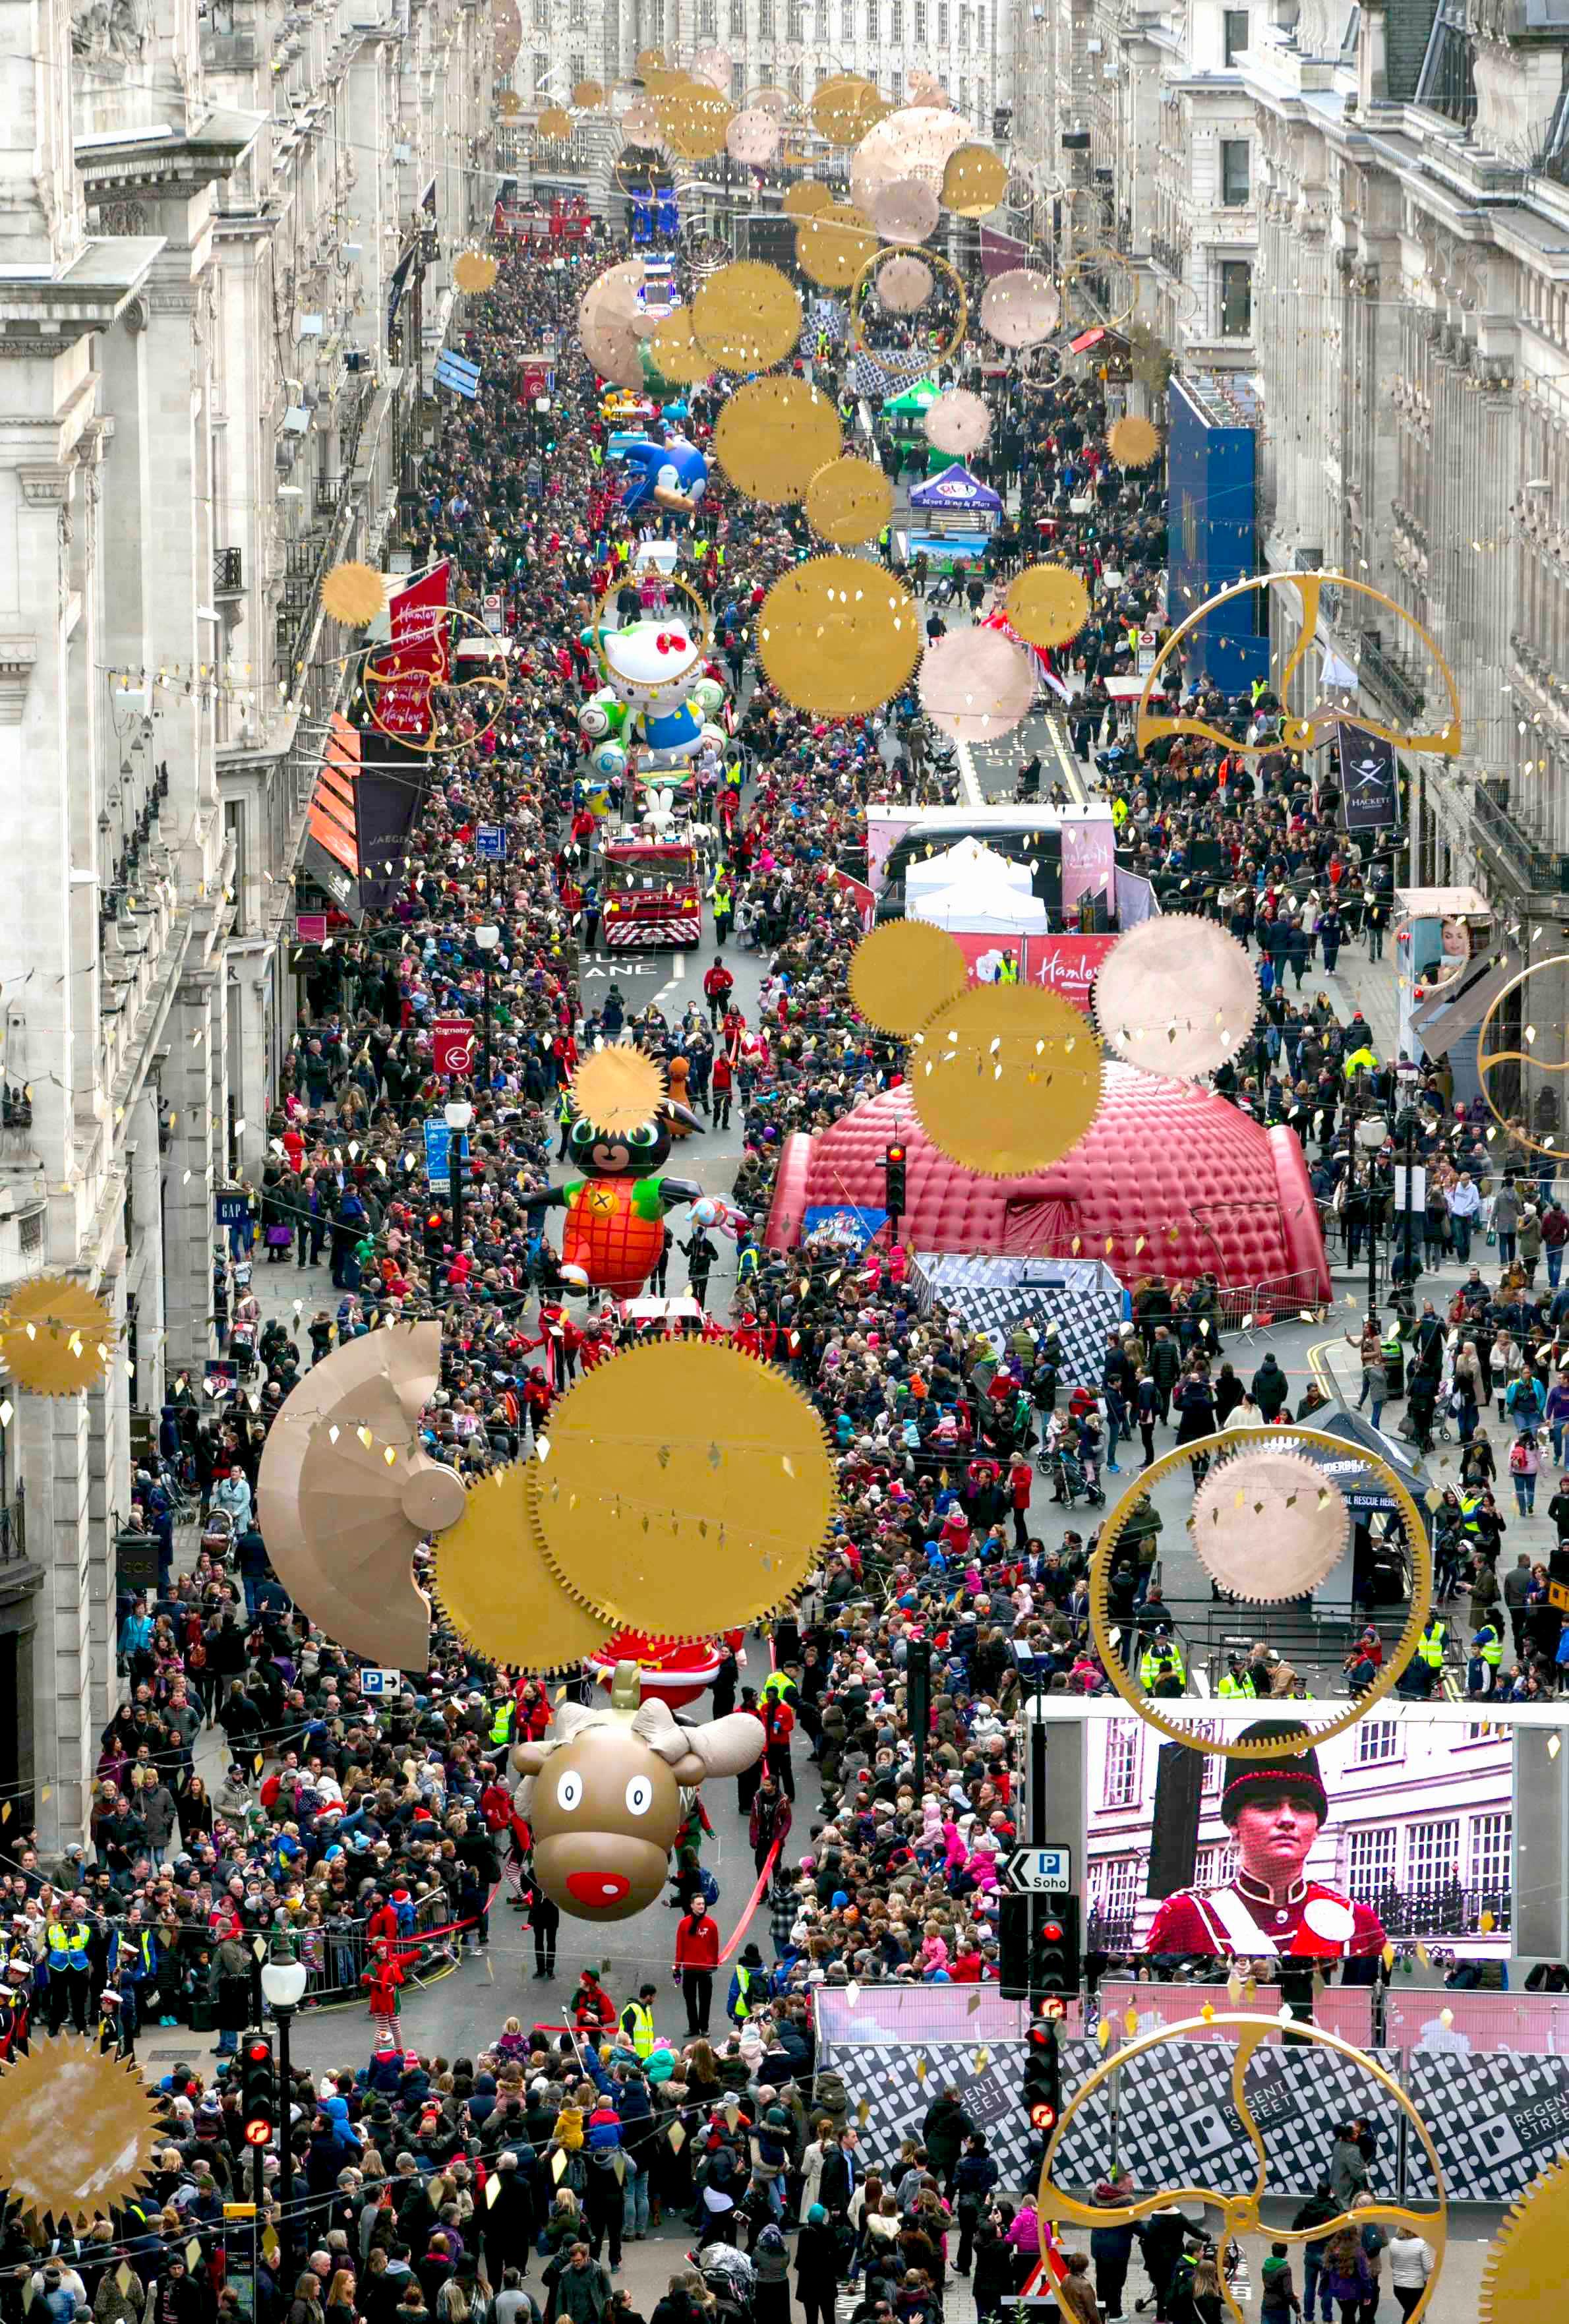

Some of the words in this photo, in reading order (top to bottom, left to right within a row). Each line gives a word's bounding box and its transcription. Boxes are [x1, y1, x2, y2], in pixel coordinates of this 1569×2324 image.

[400, 601, 436, 624] Hamley
[380, 702, 424, 729] Hamleys
[1351, 796, 1392, 806] HACKETT
[585, 963, 658, 978] ANE
[1034, 949, 1098, 985] Hamle
[222, 1203, 241, 1218] GAP
[1353, 1495, 1378, 1506] RESCUE
[1044, 1855, 1056, 1872] P
[1033, 1877, 1066, 1888] Soho
[962, 2090, 1001, 2118] REET
[1223, 2080, 1284, 2118] RGENT
[1514, 2090, 1569, 2127] REGEN
[1230, 2094, 1291, 2131] SREET
[1521, 2107, 1569, 2139] STREE
